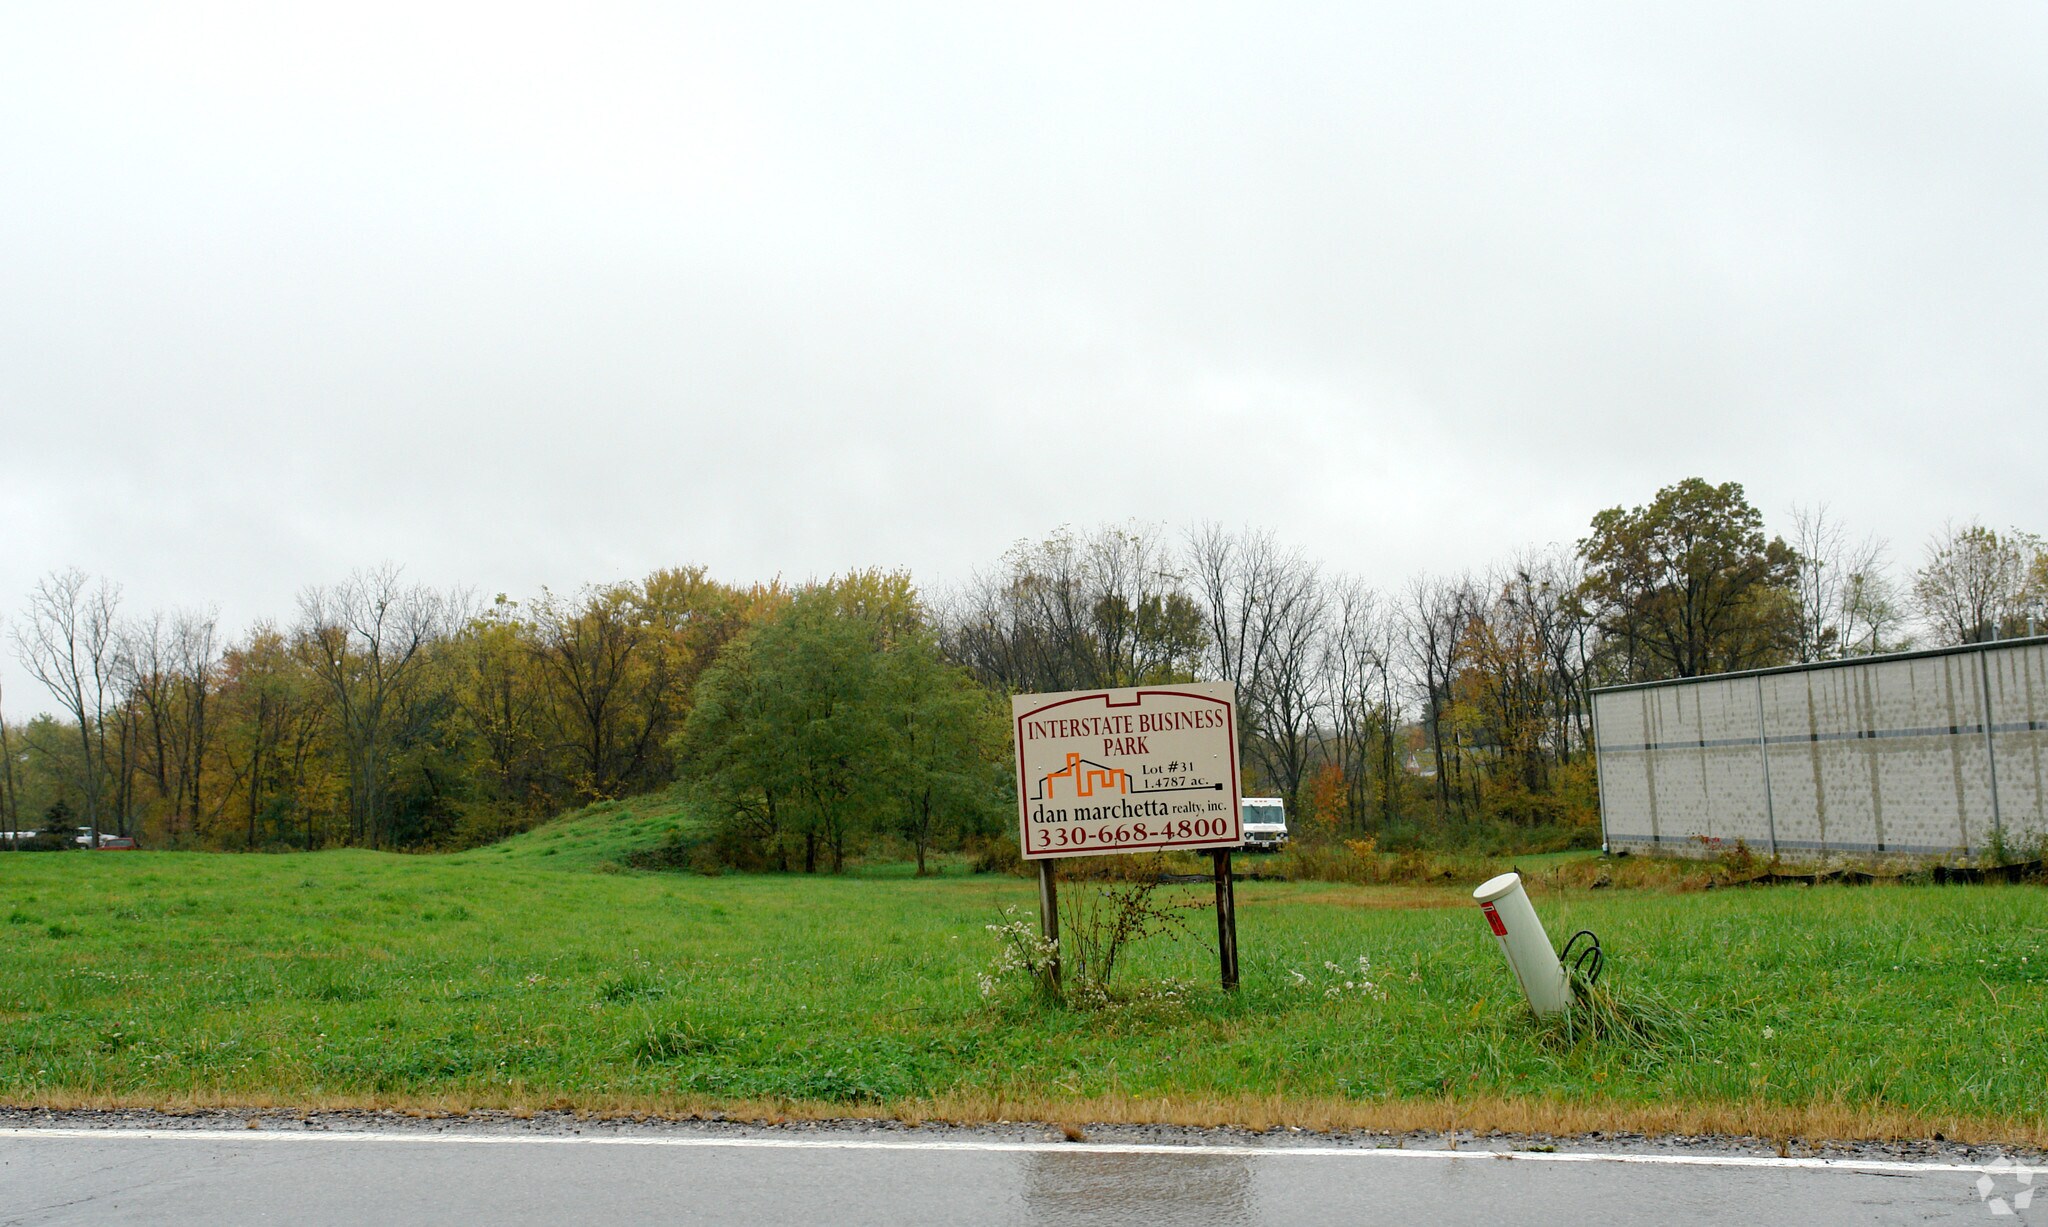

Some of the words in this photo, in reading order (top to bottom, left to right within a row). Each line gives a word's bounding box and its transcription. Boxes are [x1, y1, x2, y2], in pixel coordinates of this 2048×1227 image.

[1028, 715, 1133, 740] INTERSTATE
[1139, 708, 1224, 733] BUSINESS
[1103, 736, 1149, 756] PARK
[1142, 764, 1163, 775] Lot
[1168, 761, 1194, 773] #31
[1144, 776, 1186, 789] 1.4787
[1190, 776, 1209, 786] ac.
[1033, 804, 1067, 823] dan
[1074, 798, 1168, 821] marchetta
[1172, 801, 1205, 817] realty,
[1207, 800, 1227, 812] inc.
[1037, 817, 1227, 847] 330-668-4800
